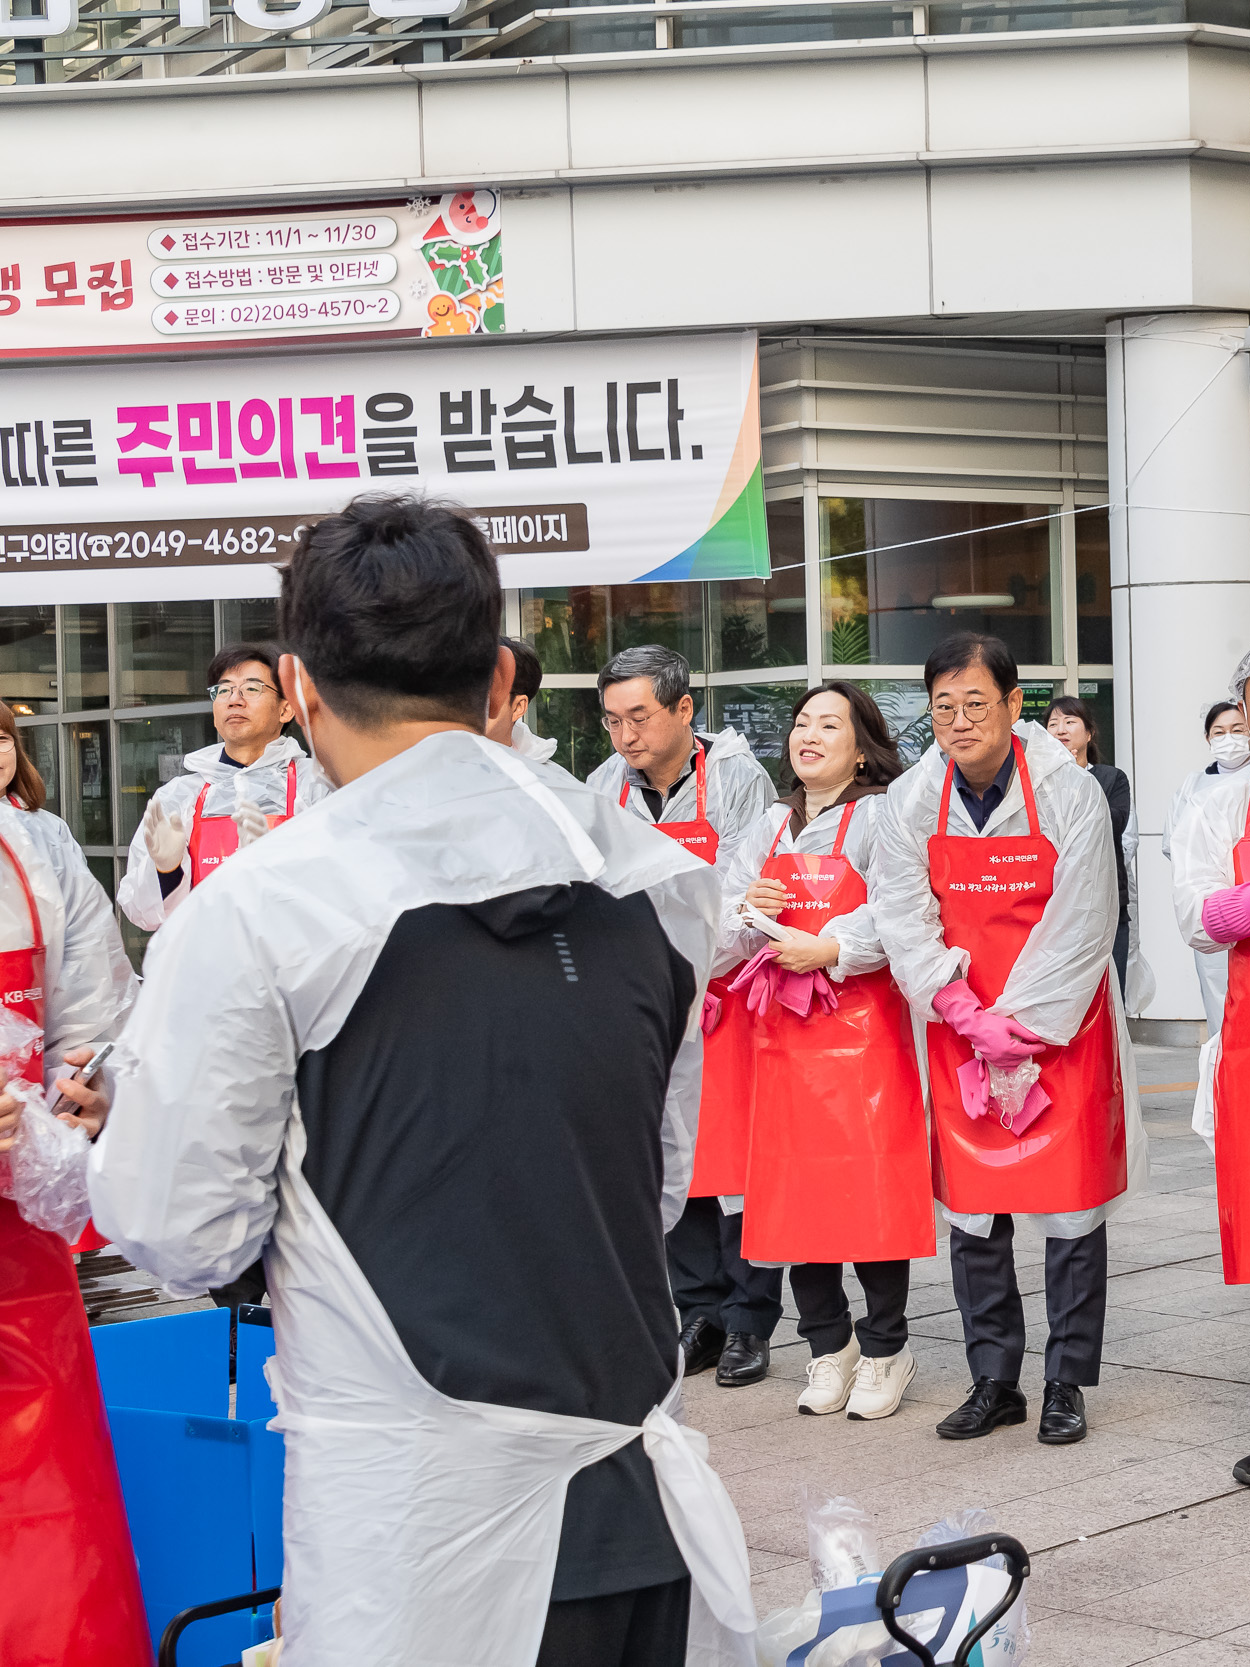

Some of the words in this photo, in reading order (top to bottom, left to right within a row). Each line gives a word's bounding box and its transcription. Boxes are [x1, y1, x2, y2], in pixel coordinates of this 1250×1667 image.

[182, 230, 251, 251] 접수기간
[265, 227, 302, 248] 11/1
[325, 223, 376, 245] 11/30
[36, 259, 134, 312] 모집
[185, 268, 252, 289] 접수방법
[267, 265, 302, 286] 방문
[308, 263, 324, 283] 및
[329, 260, 379, 282] 인터넷
[184, 308, 215, 326] 문의
[230, 297, 389, 324] 02)2049-4570~2
[0, 419, 98, 487] 따른
[117, 391, 420, 488] 주민의견을
[440, 378, 704, 474] 받습니다.
